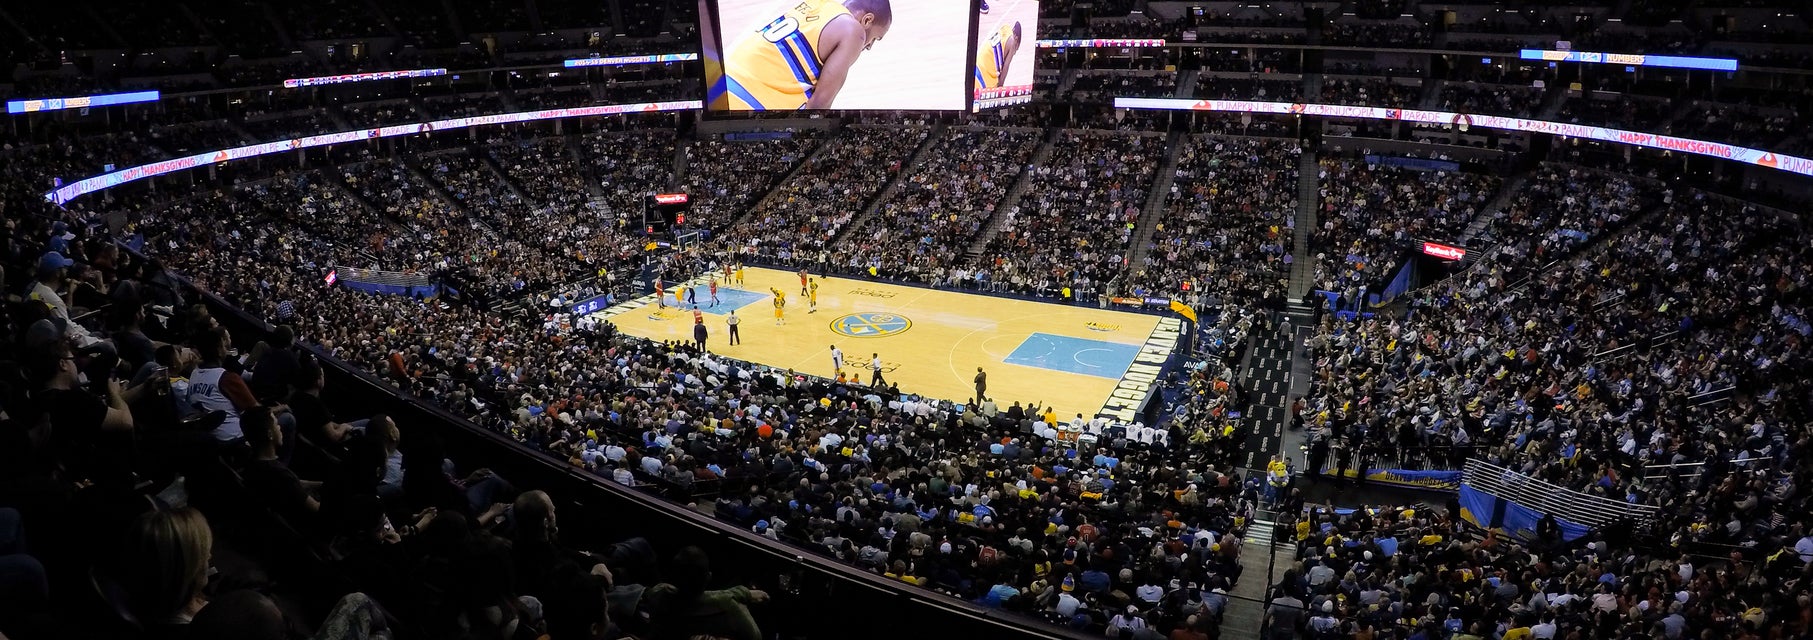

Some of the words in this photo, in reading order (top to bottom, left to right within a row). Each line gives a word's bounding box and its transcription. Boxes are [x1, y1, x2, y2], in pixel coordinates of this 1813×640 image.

[1606, 54, 1645, 64] NUMBERS
[661, 101, 695, 110] PUMPKIN
[1217, 102, 1259, 112] PUMPKIN
[1263, 103, 1275, 112] PIE
[540, 110, 563, 119] HAPPY
[566, 106, 623, 116] THANKSGIVING
[1308, 106, 1375, 117] CORNUCOPIA
[1404, 111, 1440, 121] PARADE
[435, 119, 460, 130] TURKEY
[1476, 115, 1510, 129] TURKEY
[382, 126, 410, 137] PARADE
[303, 131, 360, 146] CORNUCOPIA
[231, 143, 267, 158] PUMPKIN
[269, 143, 280, 152] PIE
[1619, 132, 1652, 145] HAPPY
[1655, 135, 1732, 158] THANKSGIVING
[123, 169, 140, 181] HAPPY
[141, 157, 195, 176] THANKSGIVING
